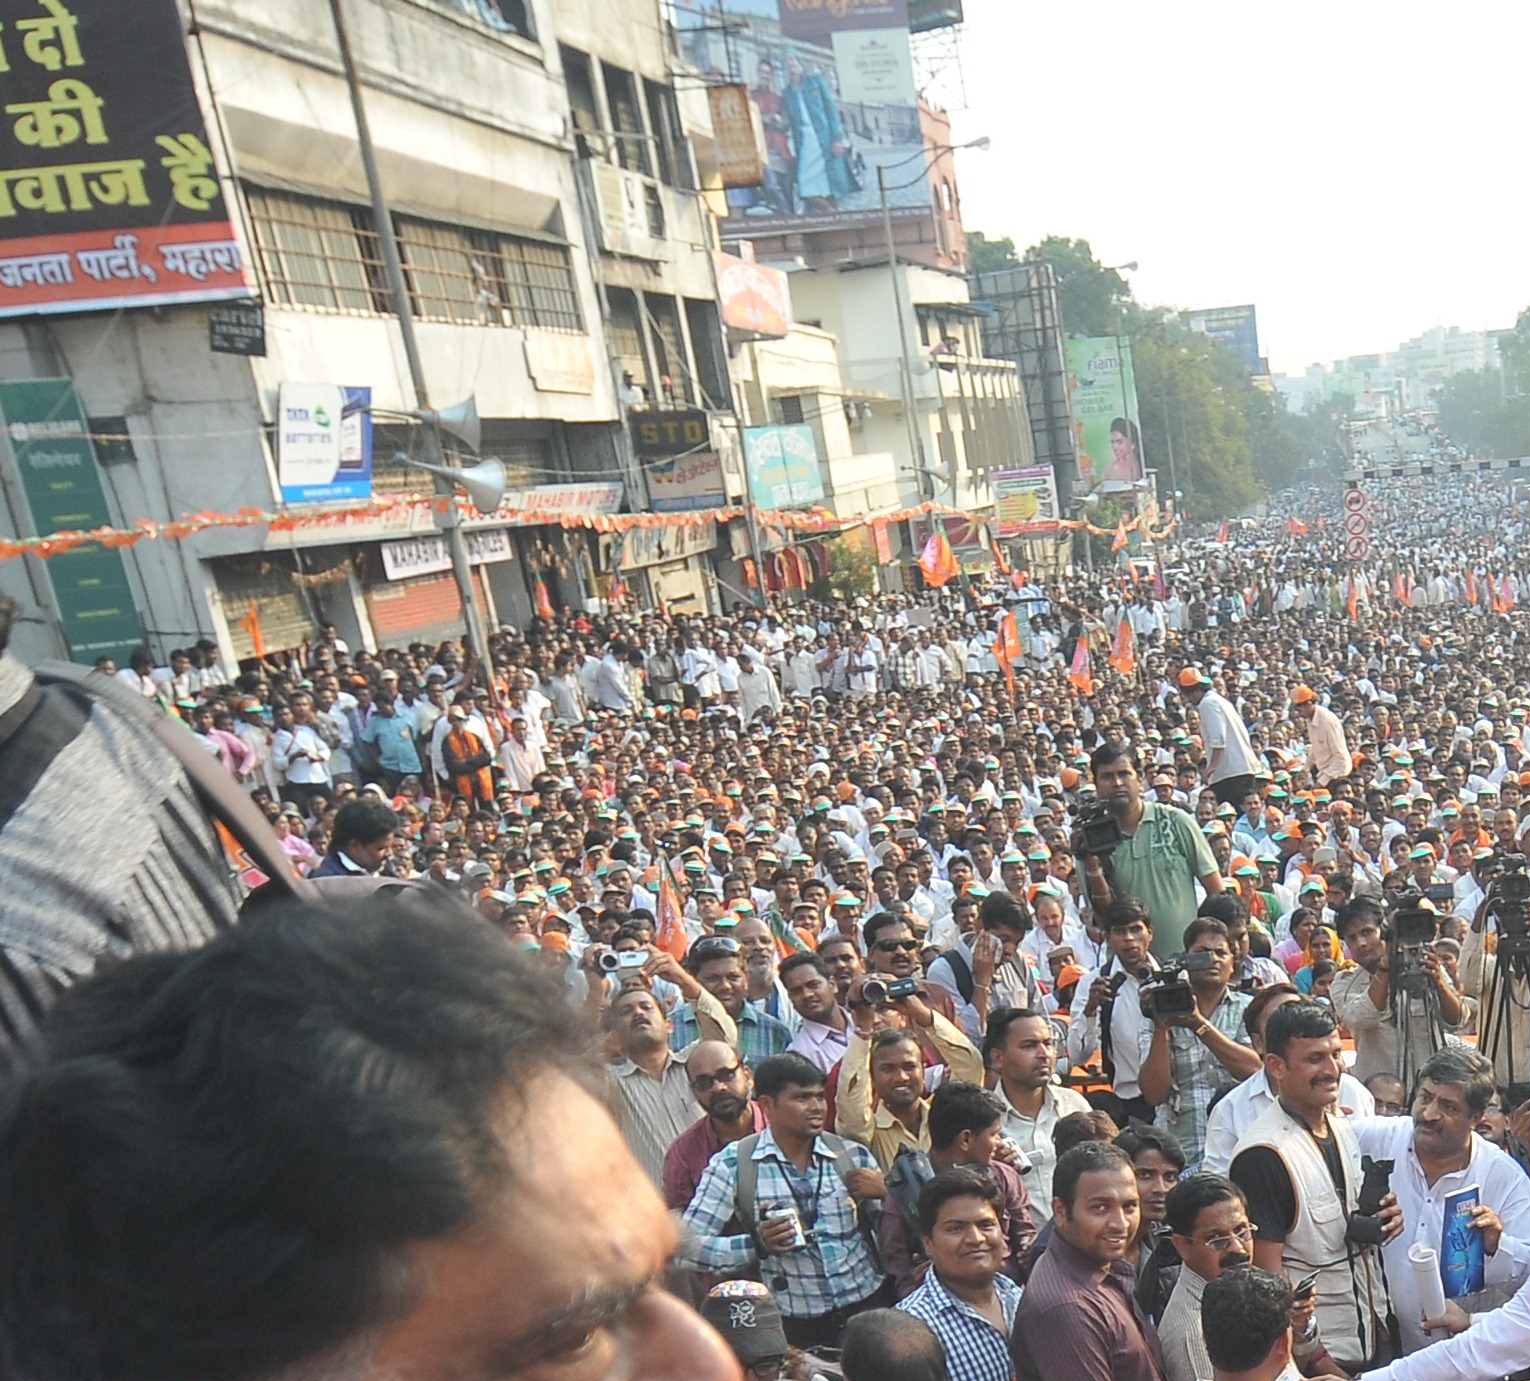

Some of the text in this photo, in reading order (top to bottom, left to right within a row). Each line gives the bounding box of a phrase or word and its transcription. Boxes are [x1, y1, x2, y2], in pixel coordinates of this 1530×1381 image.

[15, 0, 85, 71] दो
[5, 78, 110, 149] की
[155, 132, 219, 211] है
[75, 234, 158, 283] पार्टी,
[640, 420, 704, 444] STD
[388, 538, 440, 569] MAHABIR
